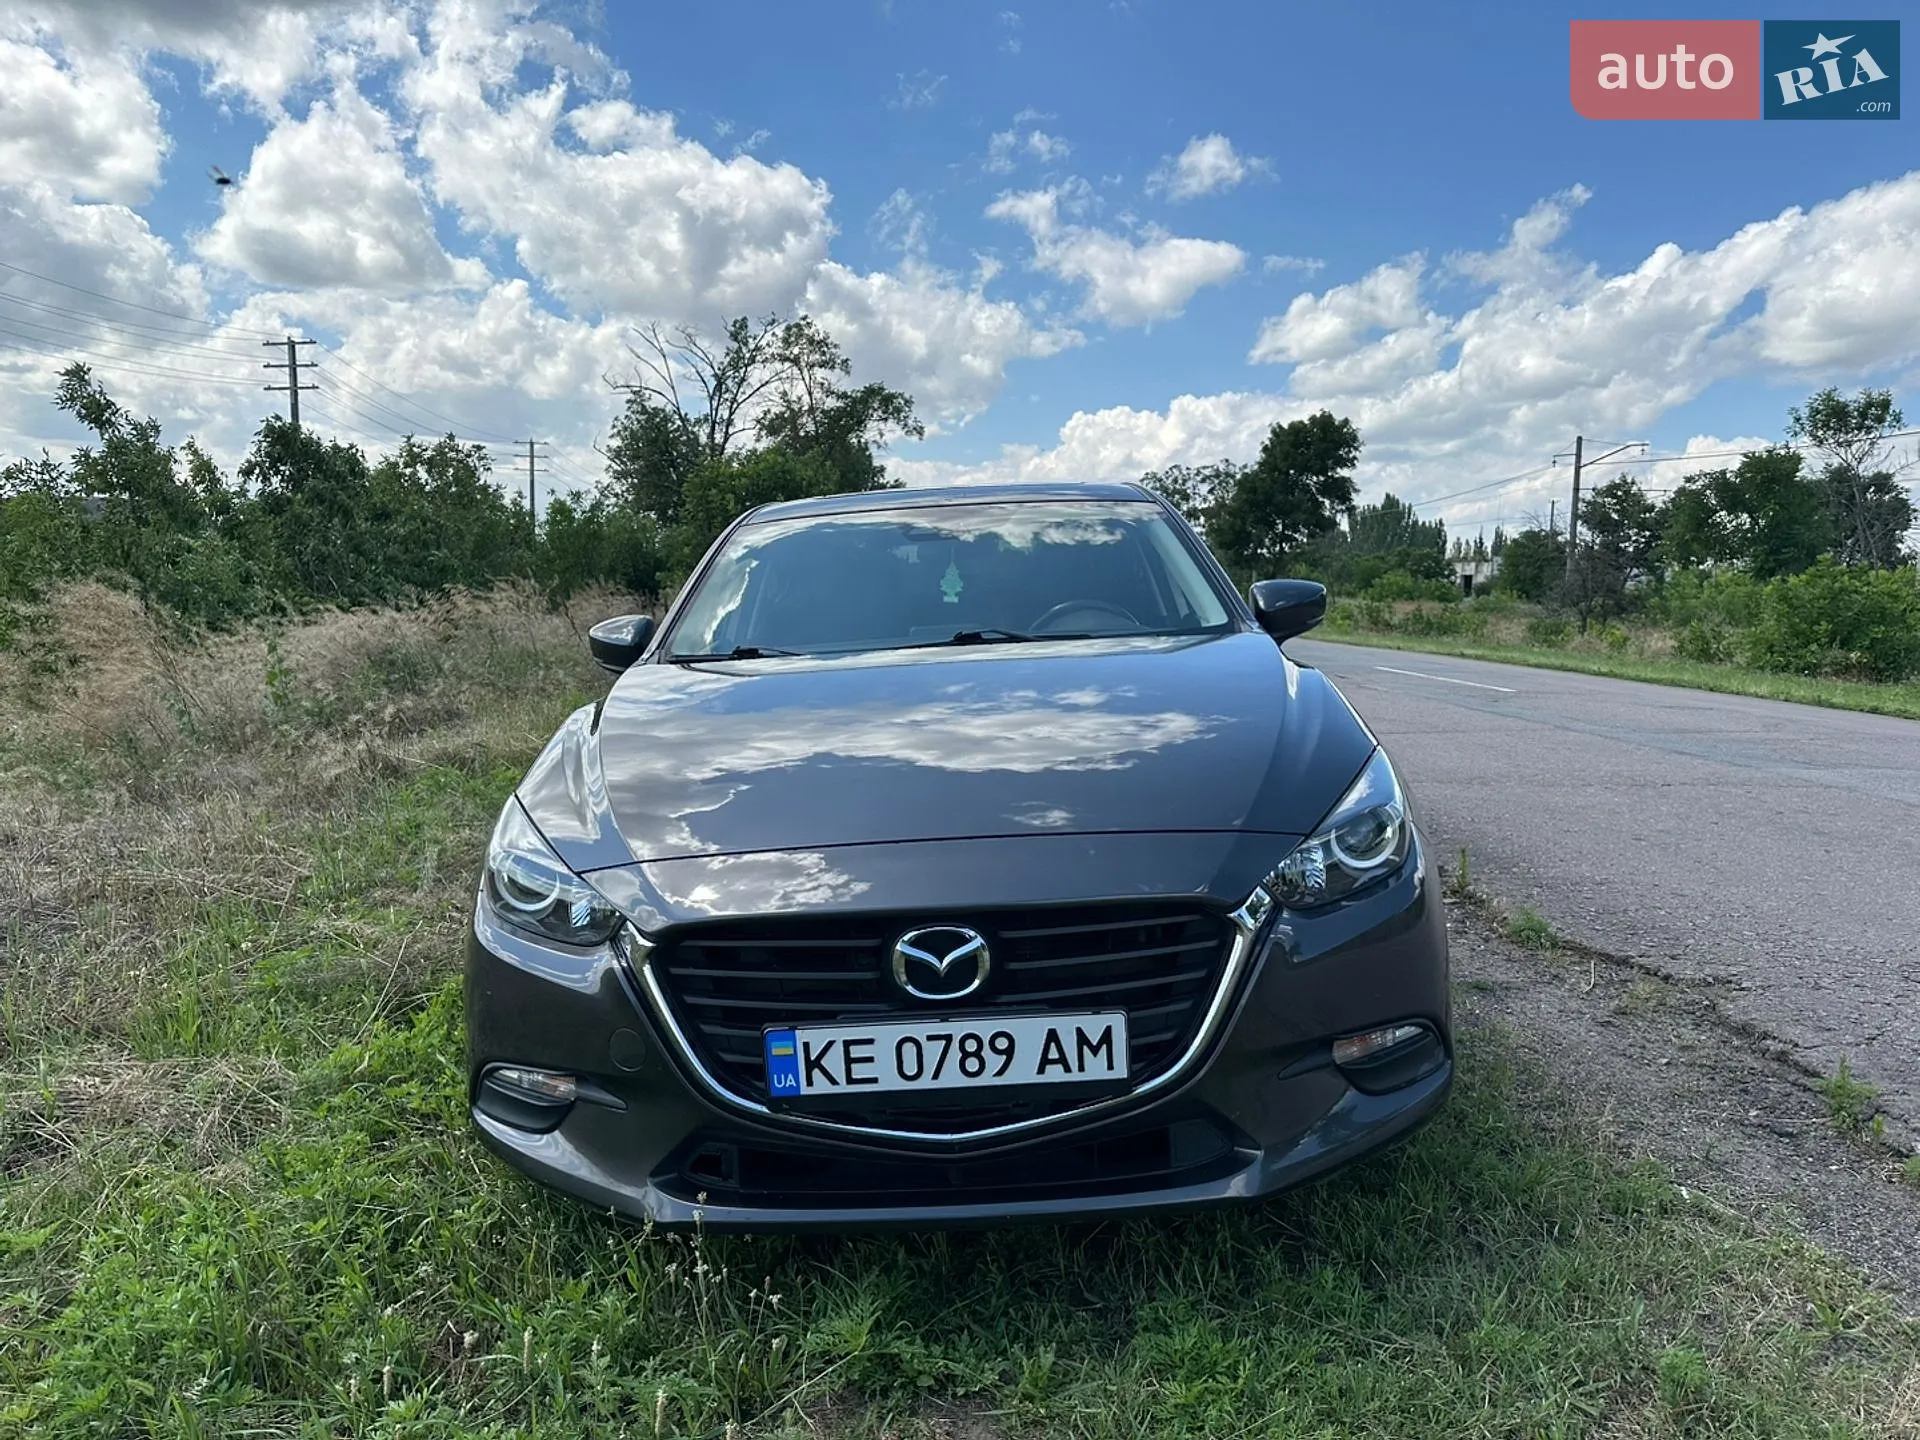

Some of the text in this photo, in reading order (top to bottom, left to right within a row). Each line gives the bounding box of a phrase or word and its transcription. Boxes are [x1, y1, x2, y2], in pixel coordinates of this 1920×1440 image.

[802, 1025, 1115, 1087] KE 0789 AM
[774, 1074, 796, 1088] UA
